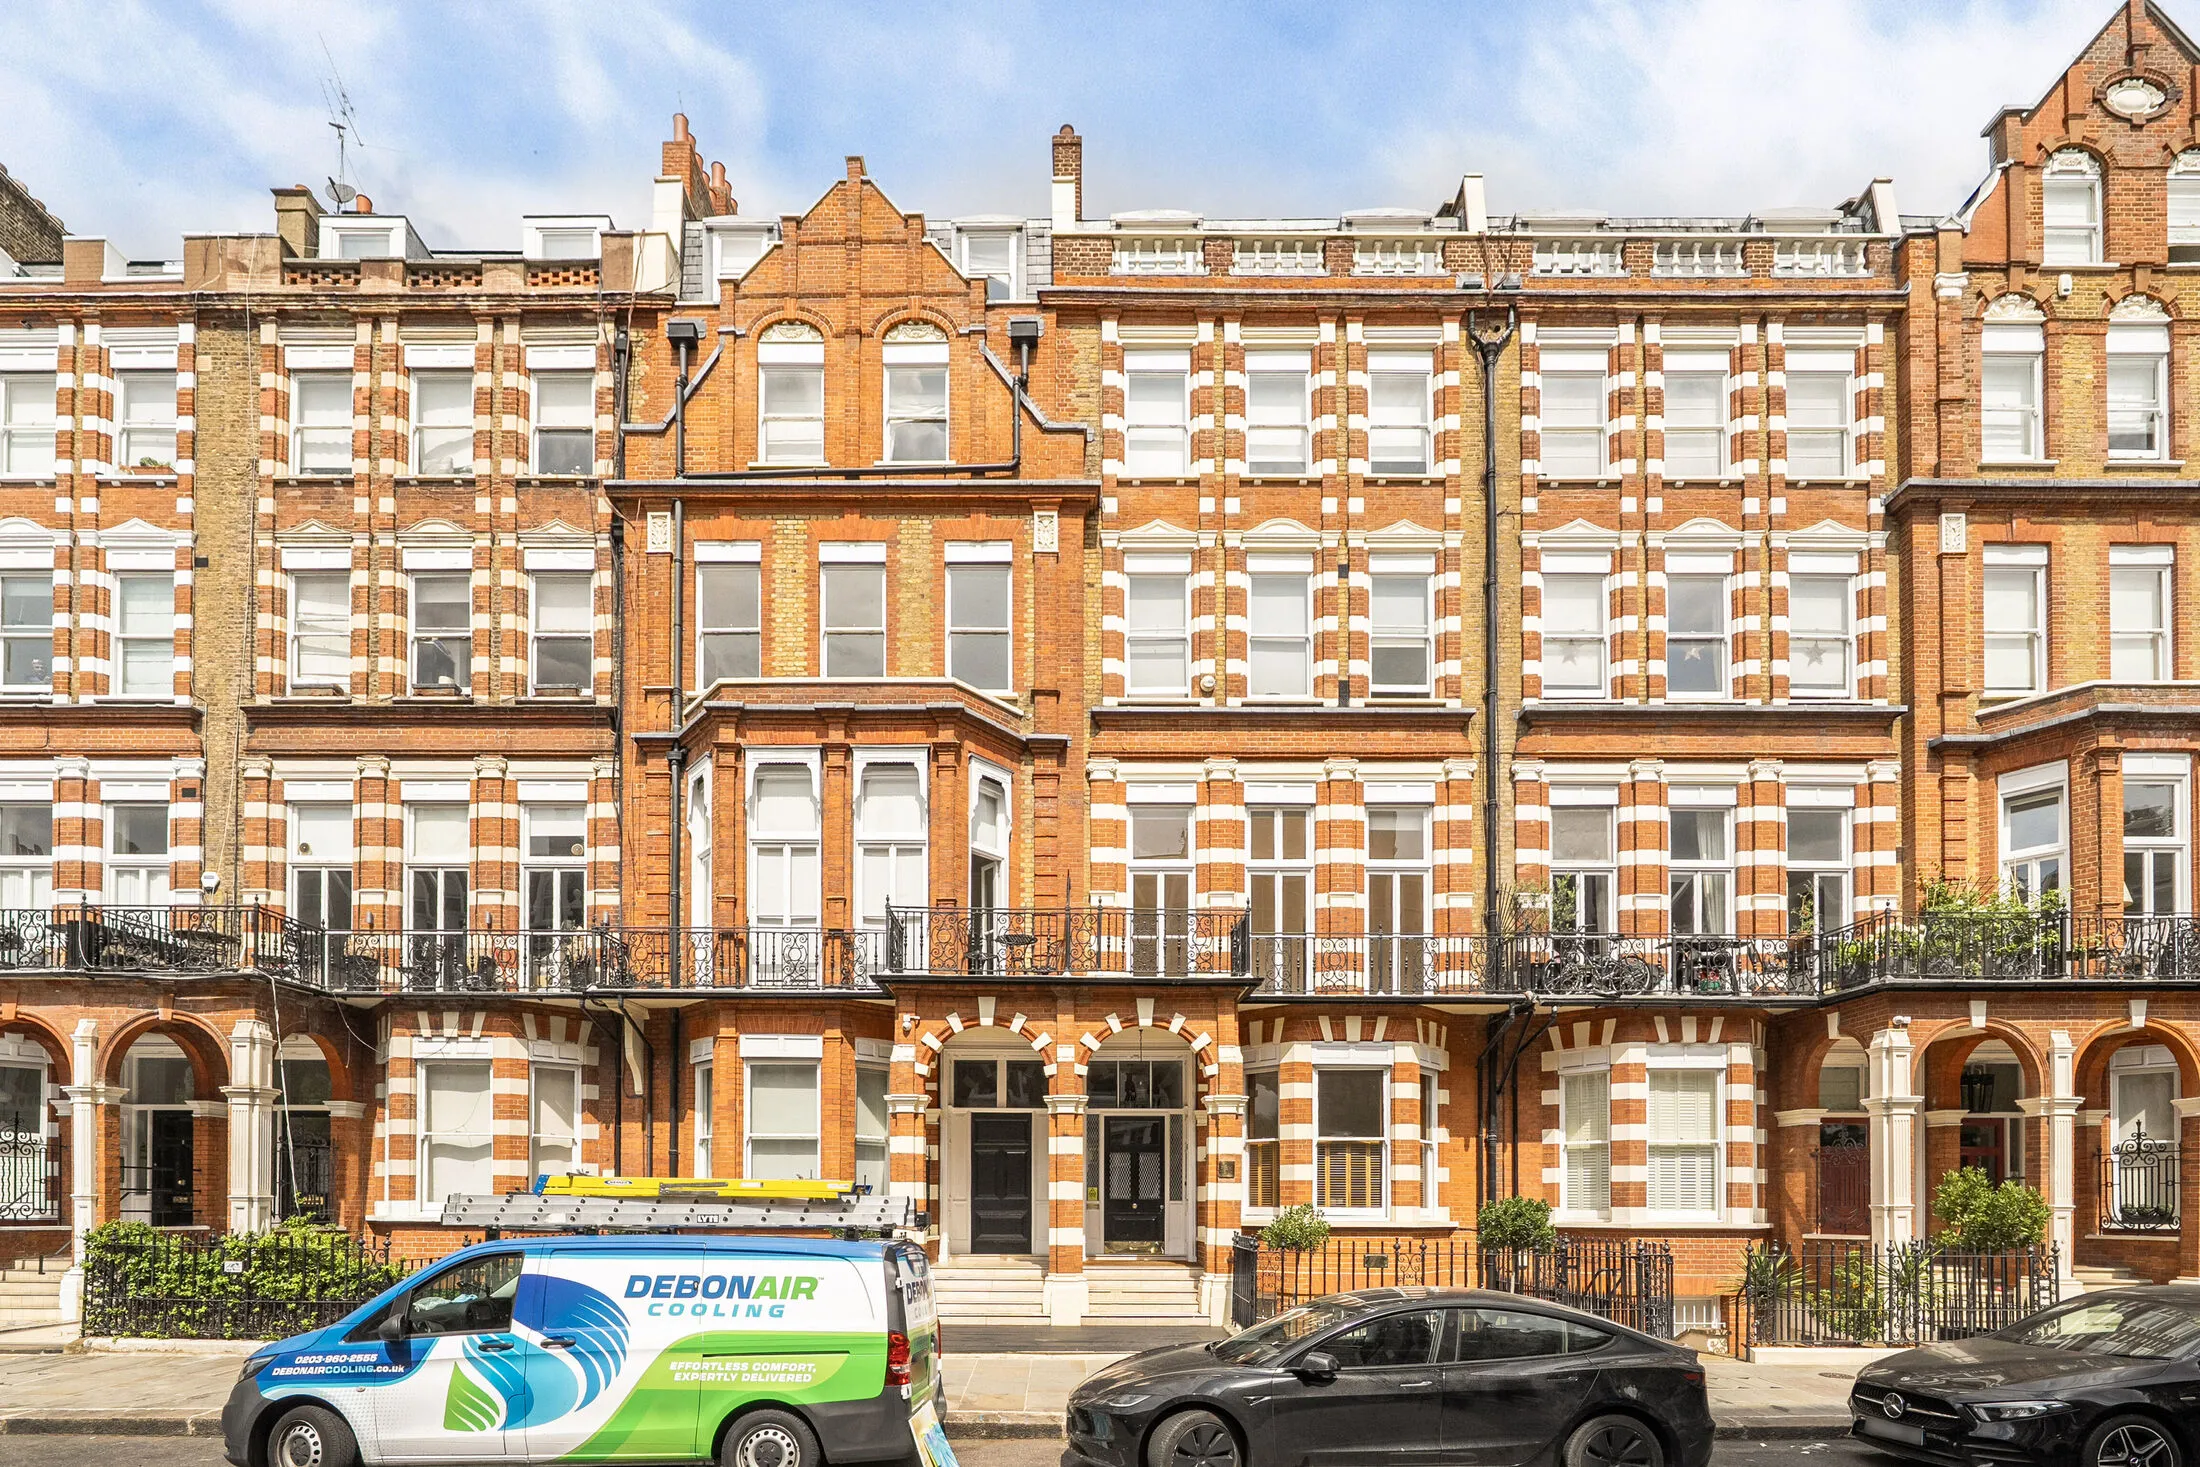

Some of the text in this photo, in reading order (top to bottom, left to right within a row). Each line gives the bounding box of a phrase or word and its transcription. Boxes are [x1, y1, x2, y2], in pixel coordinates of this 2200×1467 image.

[698, 1215, 719, 1223] LYTE
[624, 1275, 819, 1300] DEBONAIR
[647, 1303, 785, 1318] COOLING
[272, 1365, 405, 1375] DEBONAIRCOOLING.co.uk
[669, 1361, 816, 1373] EFFORTLESS COMFORT,
[673, 1372, 812, 1383] EXPERTLY DELIVERED
